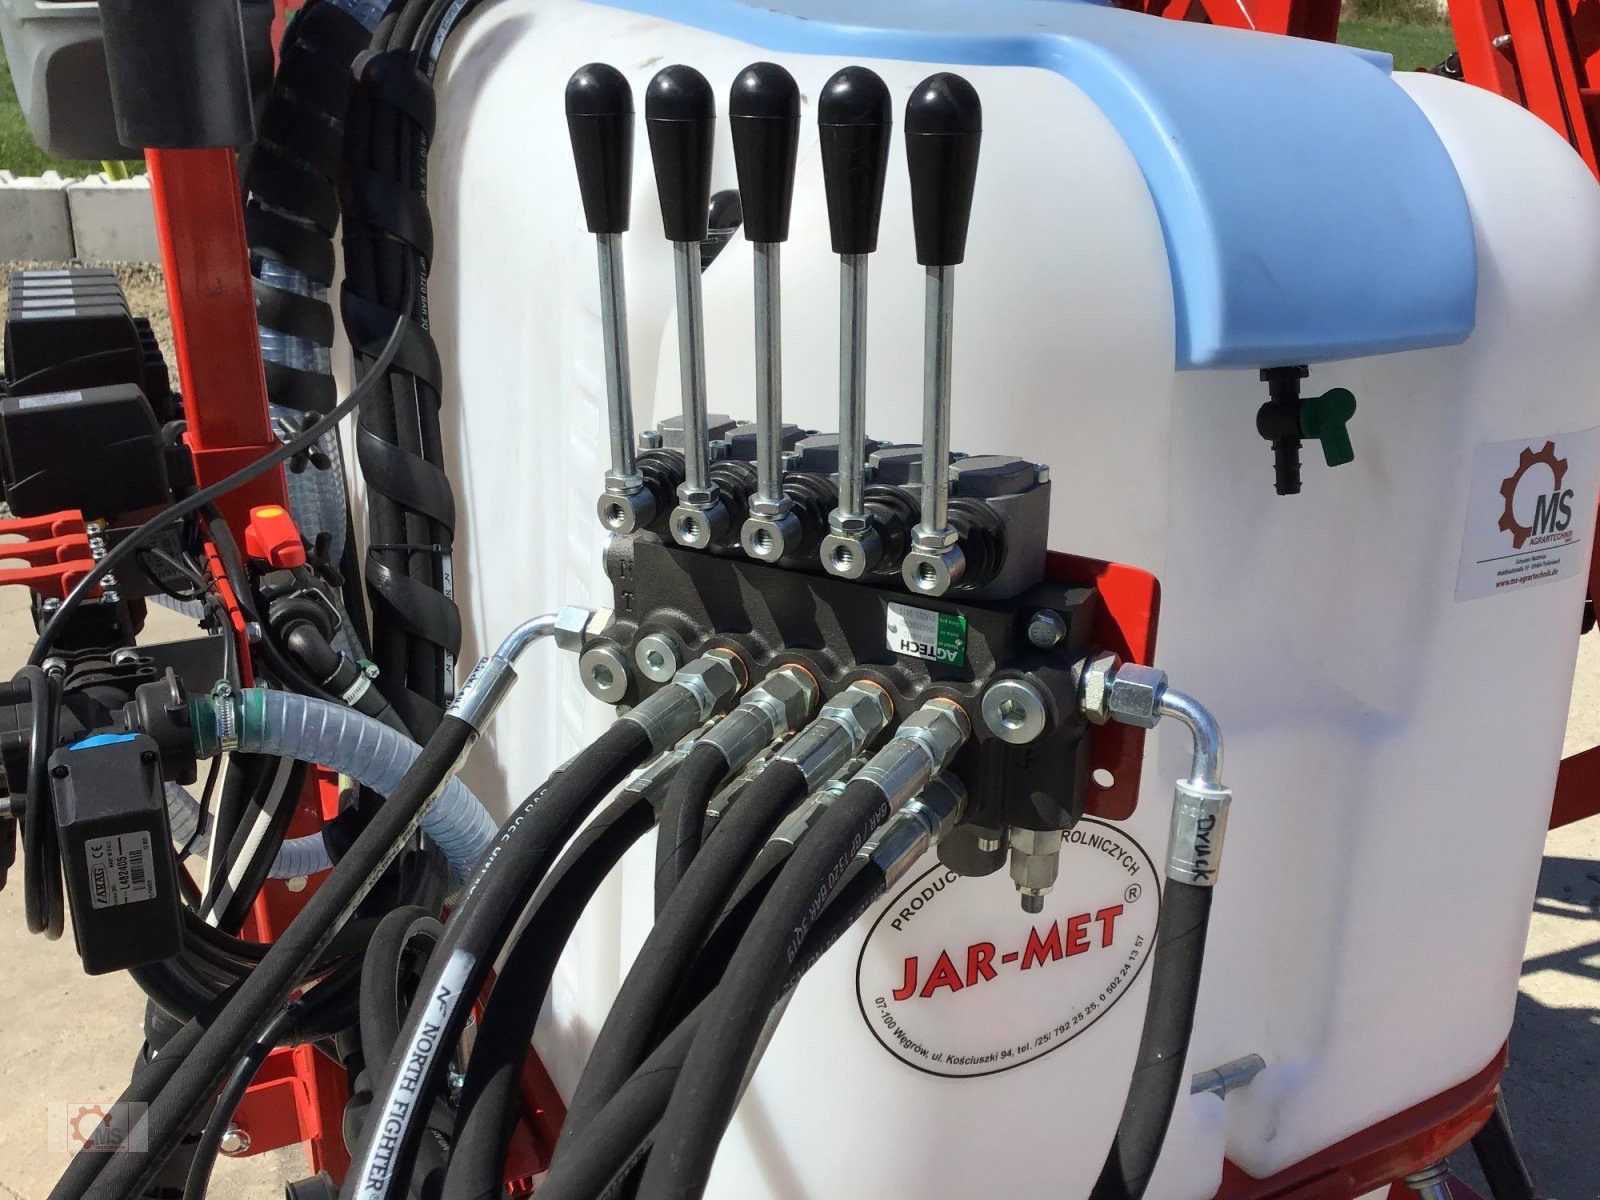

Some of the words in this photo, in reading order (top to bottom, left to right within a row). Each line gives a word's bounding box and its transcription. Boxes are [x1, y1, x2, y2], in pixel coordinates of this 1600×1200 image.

[1532, 489, 1574, 536] MS
[1529, 529, 1574, 546] AGRARTECHNIK
[900, 639, 958, 662] AGTECH
[869, 801, 887, 831] BAR
[850, 832, 861, 858] BP
[117, 856, 130, 890] L482405
[828, 852, 849, 889] 1320
[890, 870, 958, 932] PRODUC
[1061, 830, 1141, 876] ROLNICZYCH
[808, 884, 827, 921] BAR
[892, 904, 1124, 1001] JAR-MET
[875, 996, 897, 1029] 07-100
[893, 1026, 930, 1059] Węgrów,
[931, 1052, 944, 1063] ul.
[945, 1052, 999, 1066] Kościuszki
[1000, 1048, 1015, 1060] 94,
[1017, 1042, 1033, 1055] tel.
[1053, 1022, 1071, 1037] 792
[1072, 1012, 1084, 1025] 25
[1085, 1002, 1100, 1015] 25,
[1099, 993, 1107, 1002] 0
[1106, 976, 1122, 994] 502
[1120, 963, 1132, 977] 24
[1128, 949, 1139, 961] 13
[1135, 935, 1145, 948] 57
[398, 1021, 441, 1095] NORTH
[365, 1098, 409, 1192] FIGHTER
